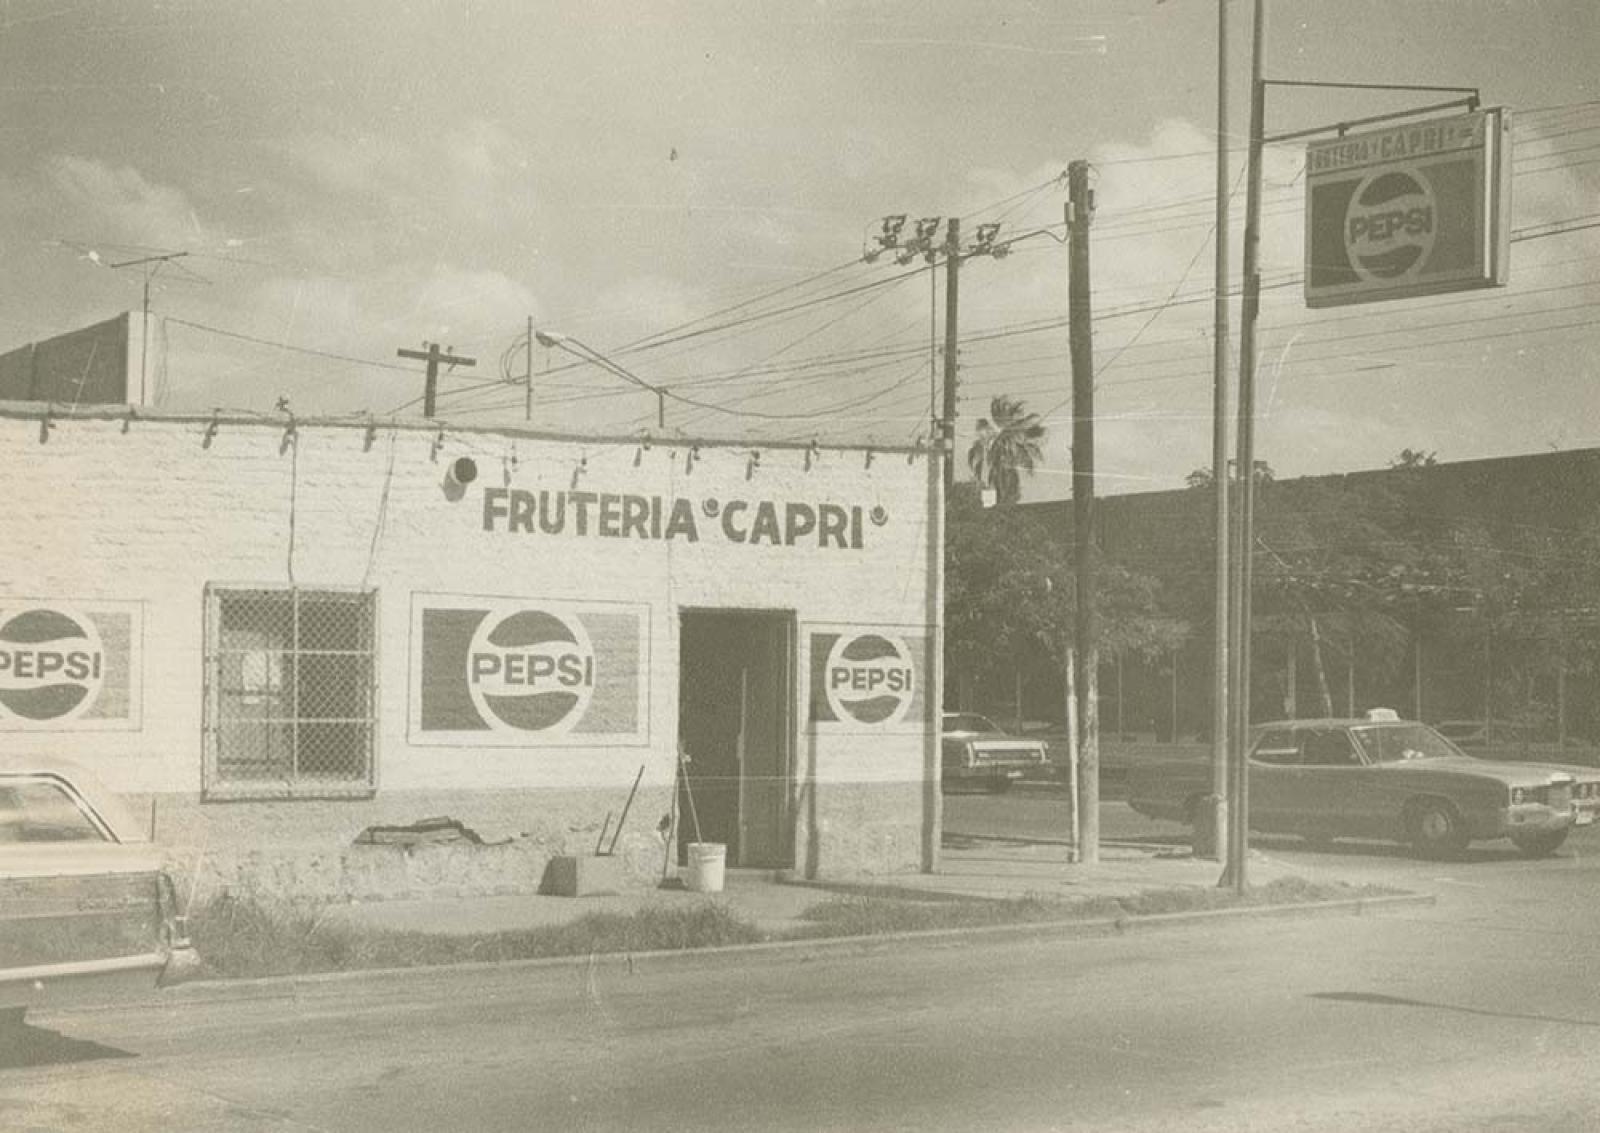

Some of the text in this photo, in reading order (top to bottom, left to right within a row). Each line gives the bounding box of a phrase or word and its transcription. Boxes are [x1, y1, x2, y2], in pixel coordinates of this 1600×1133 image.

[1350, 205, 1432, 244] PEPSI
[482, 487, 699, 542] FRUTERIA
[472, 653, 593, 687] PEPSI
[831, 667, 912, 692] PEPSI
